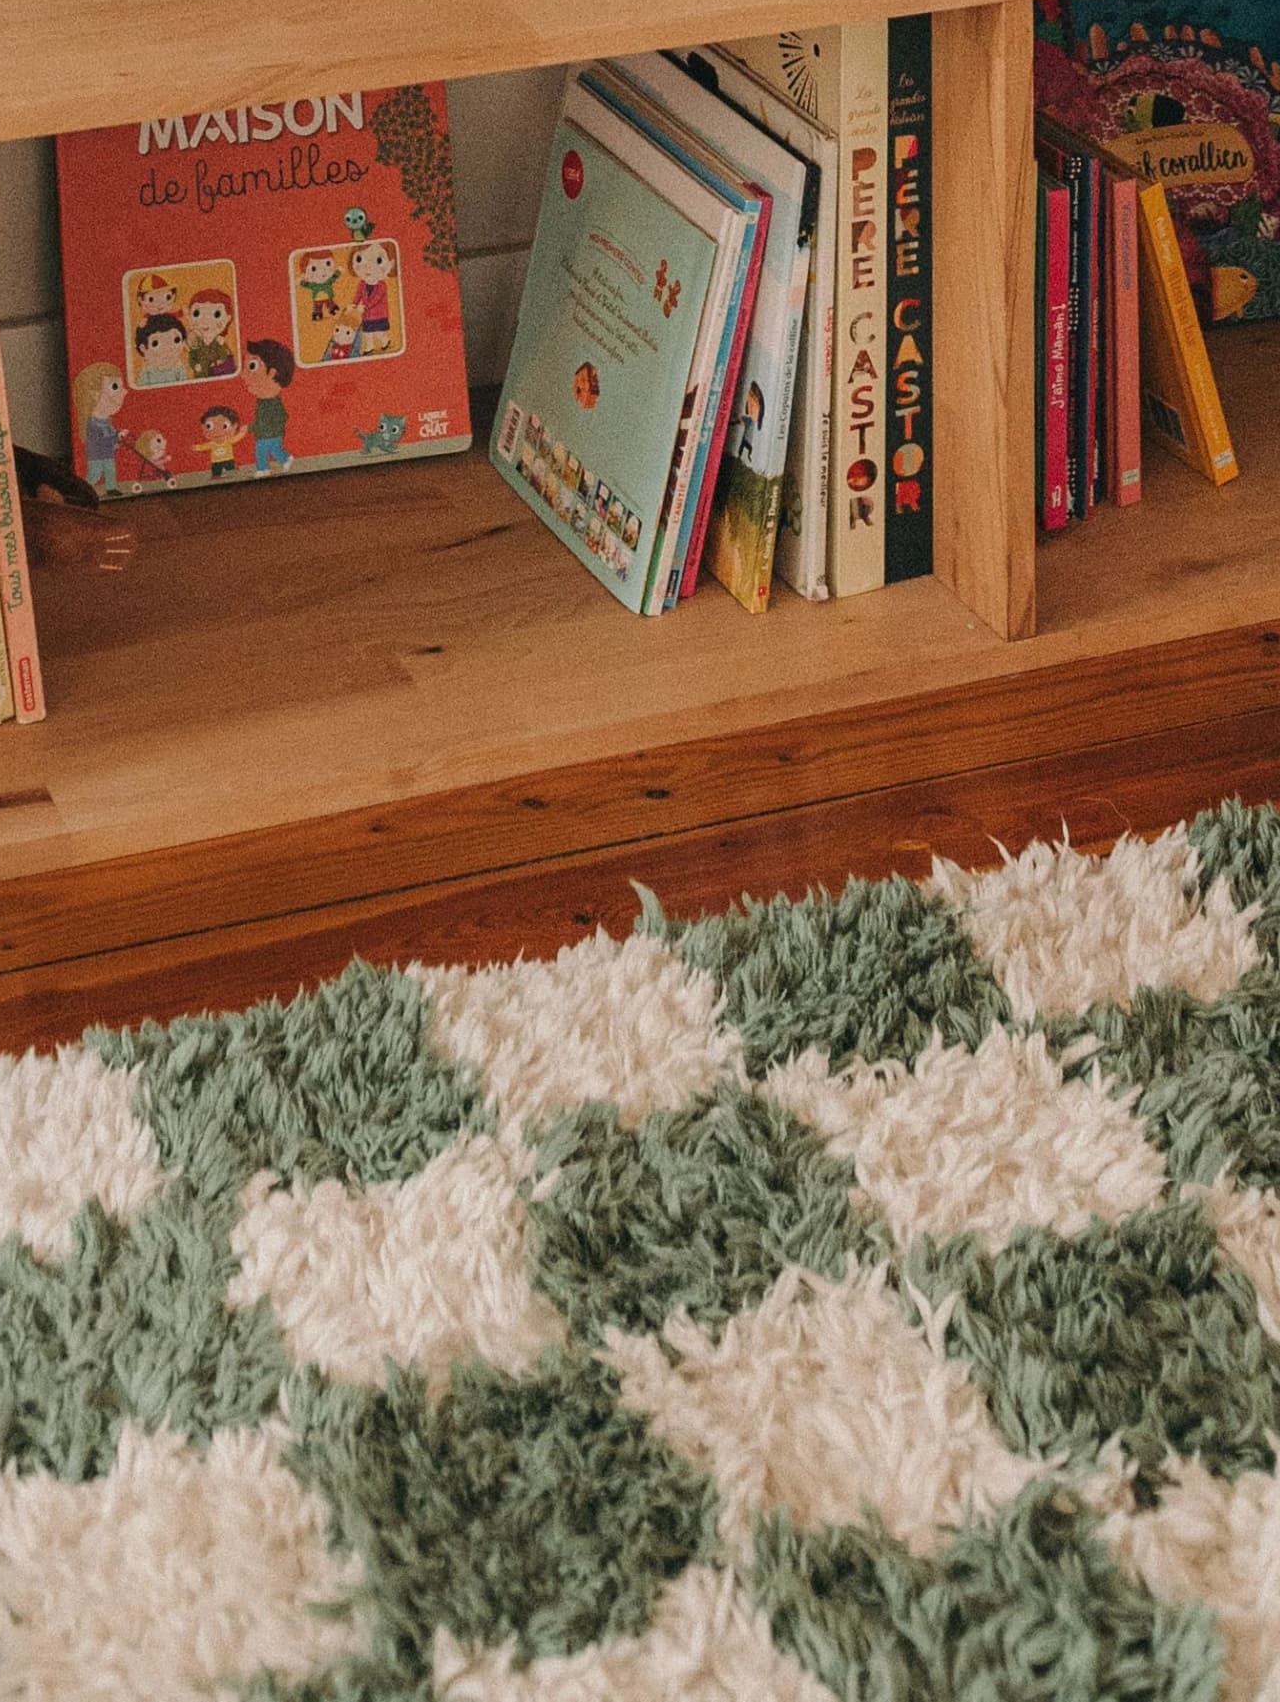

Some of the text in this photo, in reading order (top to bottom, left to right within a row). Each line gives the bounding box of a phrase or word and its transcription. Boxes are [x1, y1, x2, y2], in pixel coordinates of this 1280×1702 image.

[138, 91, 365, 155] MAISON
[139, 142, 370, 213] de familles
[1159, 140, 1247, 177] corallien
[786, 318, 799, 353] colline
[783, 369, 792, 381] de
[1051, 363, 1065, 407] J'aime
[778, 382, 793, 421] Copains
[846, 311, 878, 531] CASTOR
[892, 297, 925, 515] CASTOR
[419, 423, 449, 438] CHAT
[819, 429, 831, 450] suis
[820, 452, 829, 461] le
[814, 461, 832, 507] meilleur
[4, 530, 19, 565] mes
[3, 569, 25, 613] Tous
[20, 659, 34, 710] casterman
